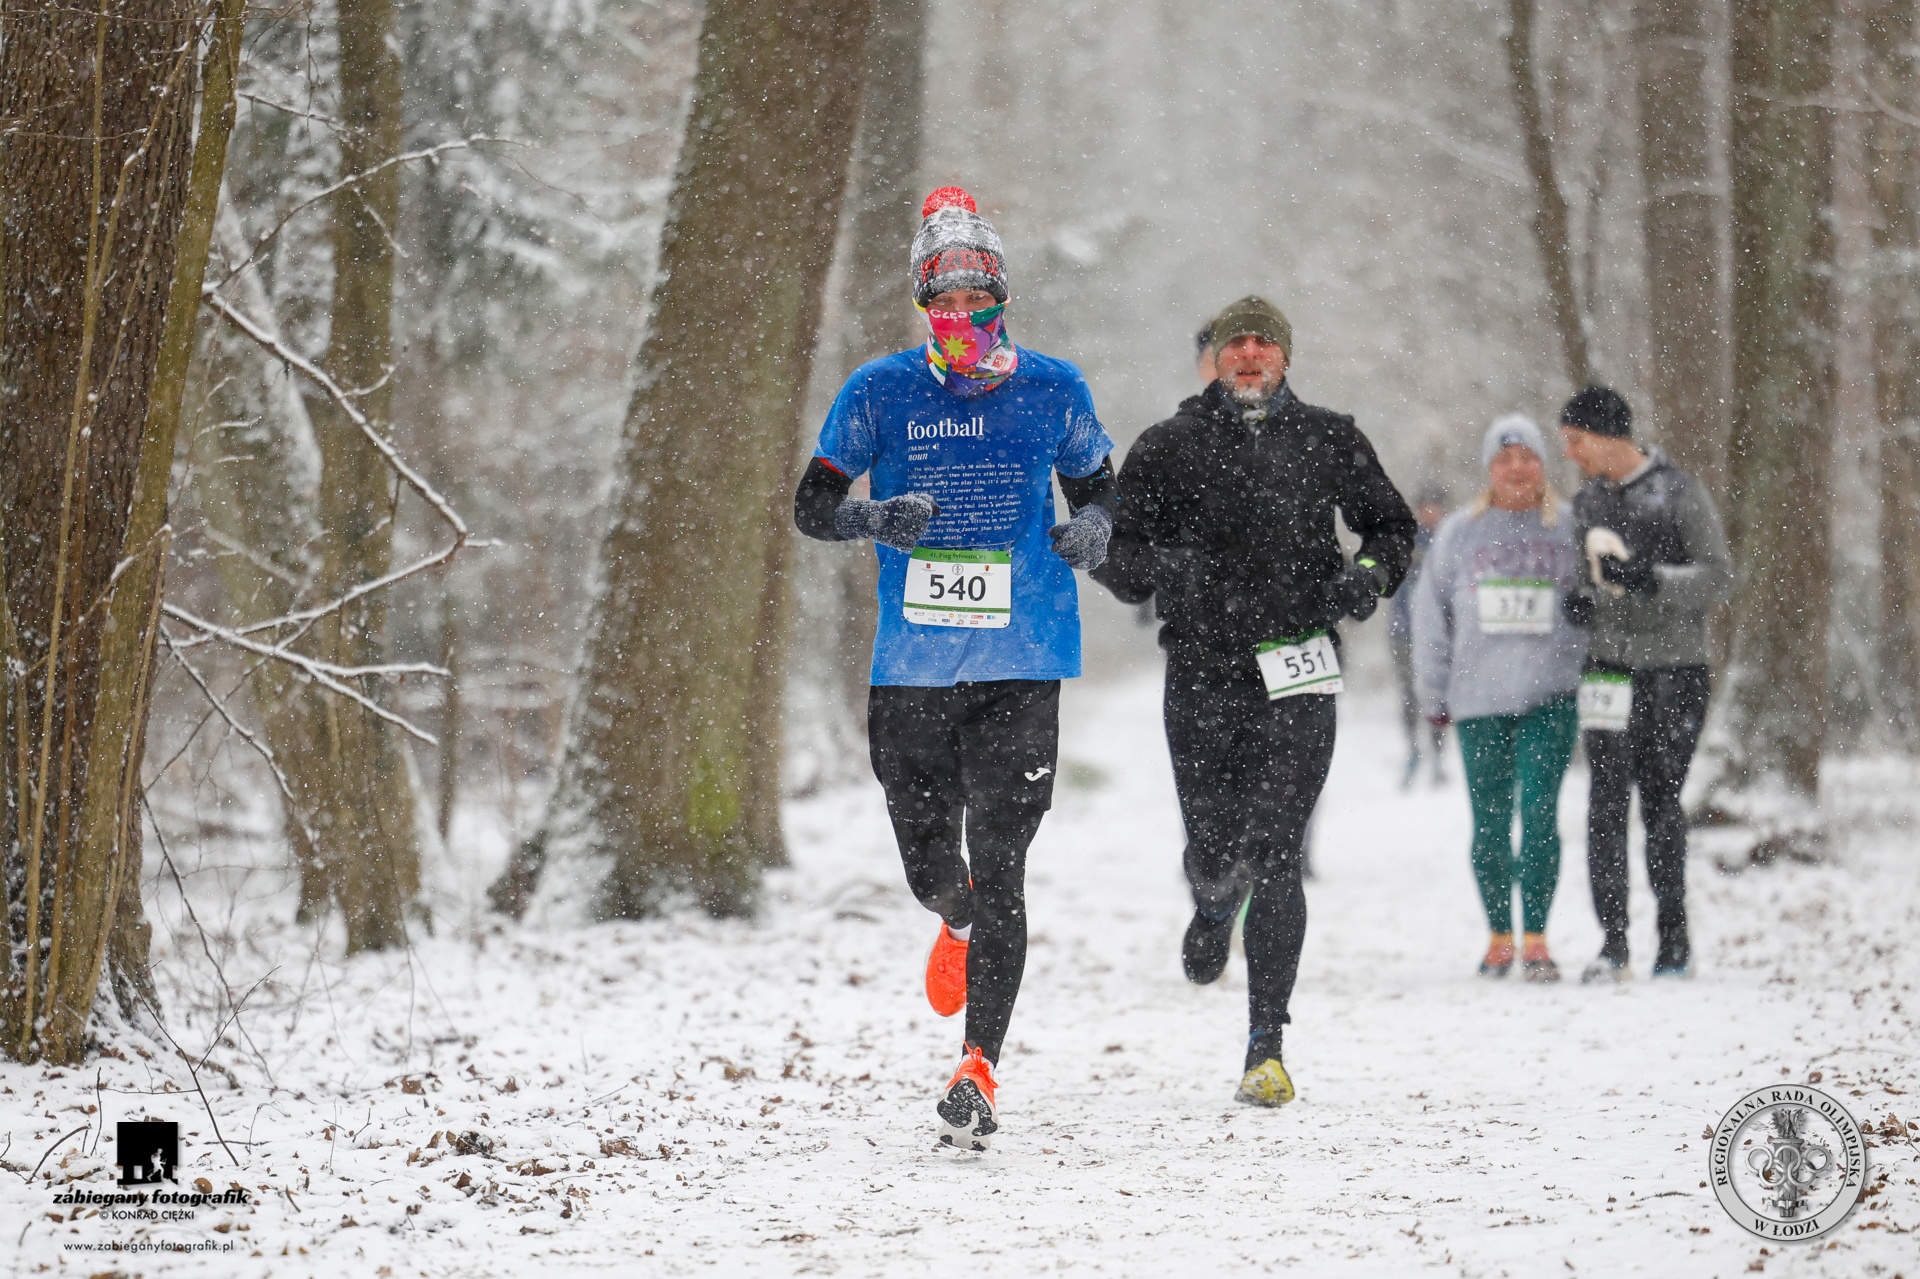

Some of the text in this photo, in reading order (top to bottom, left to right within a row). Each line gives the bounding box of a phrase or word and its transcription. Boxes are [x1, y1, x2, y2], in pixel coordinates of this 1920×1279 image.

[907, 417, 984, 440] football
[929, 574, 986, 602] 540
[1284, 650, 1327, 679] 551
